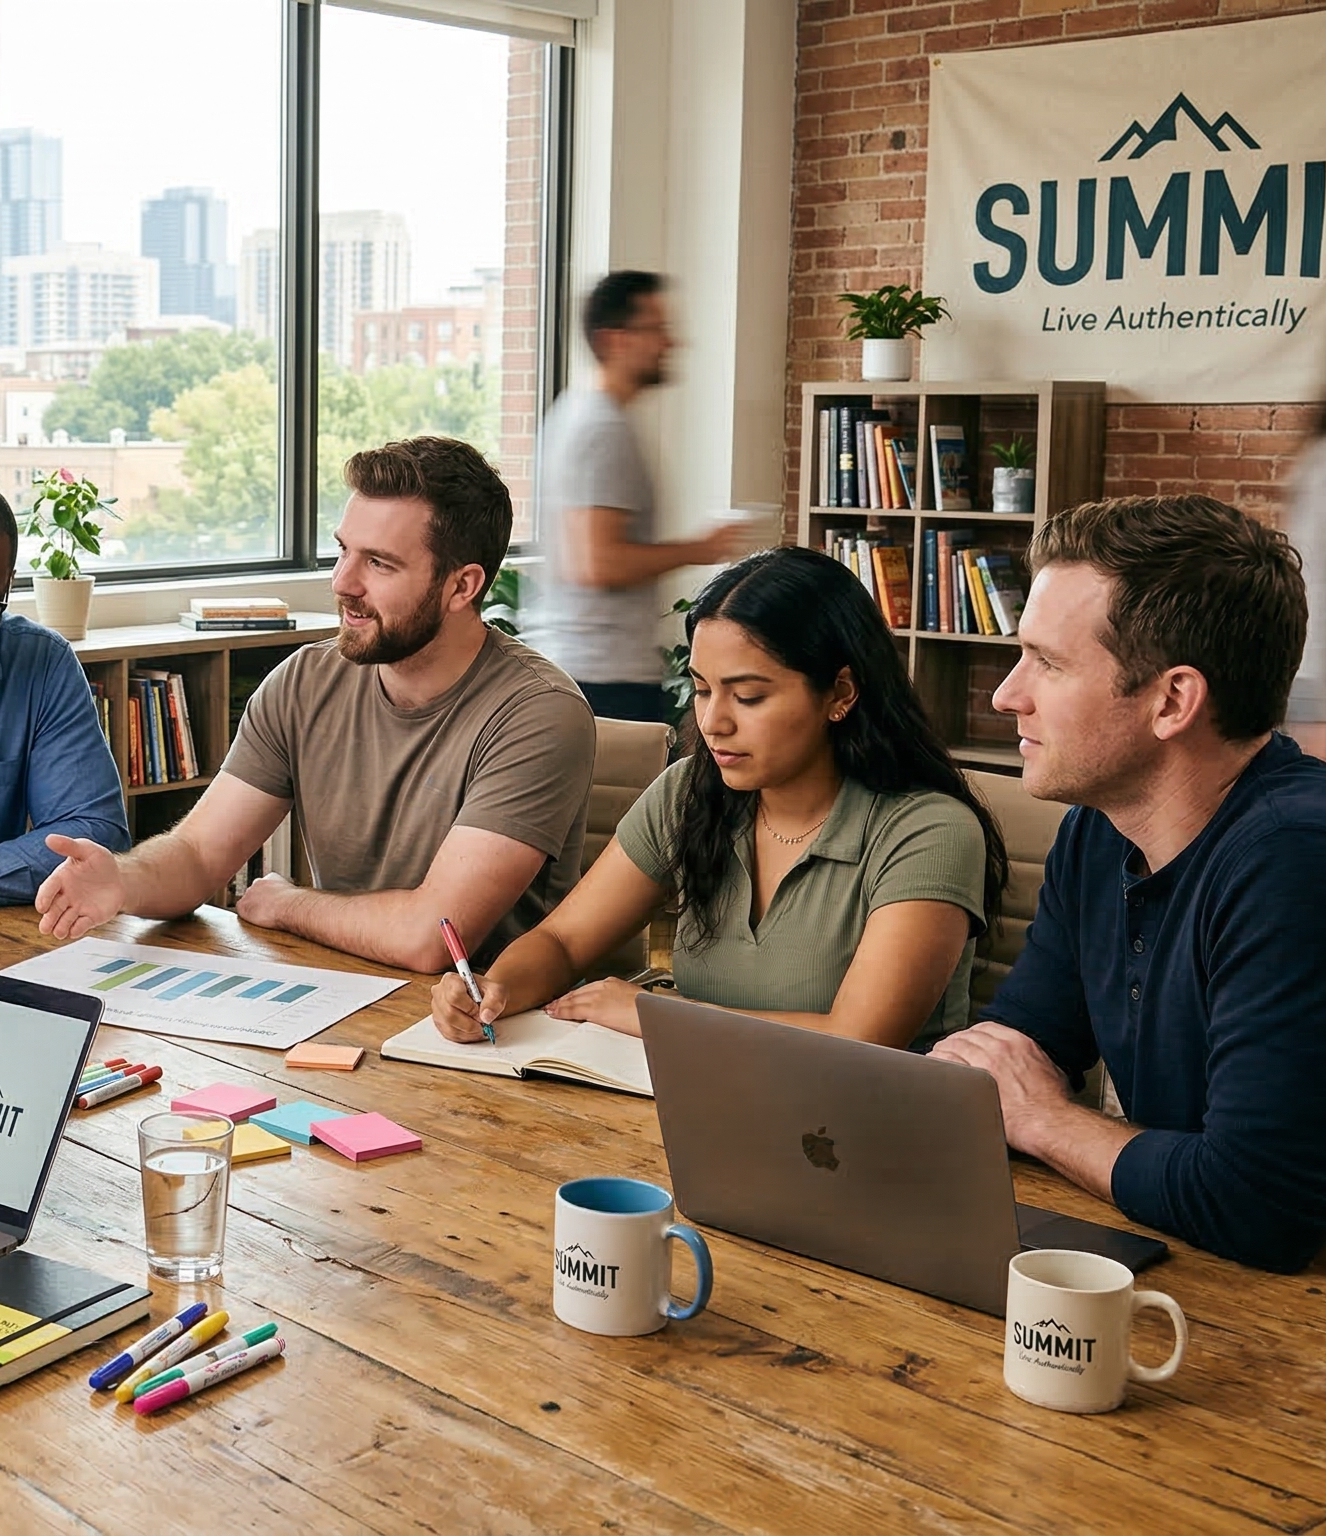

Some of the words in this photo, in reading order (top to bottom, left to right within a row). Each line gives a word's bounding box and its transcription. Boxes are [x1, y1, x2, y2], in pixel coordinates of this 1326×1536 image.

[973, 161, 1326, 294] SUMMI
[1042, 306, 1098, 332] Live
[1104, 298, 1308, 334] Authentically
[555, 1248, 620, 1289] SUMMIT
[1013, 1321, 1097, 1363] SUMMIT
